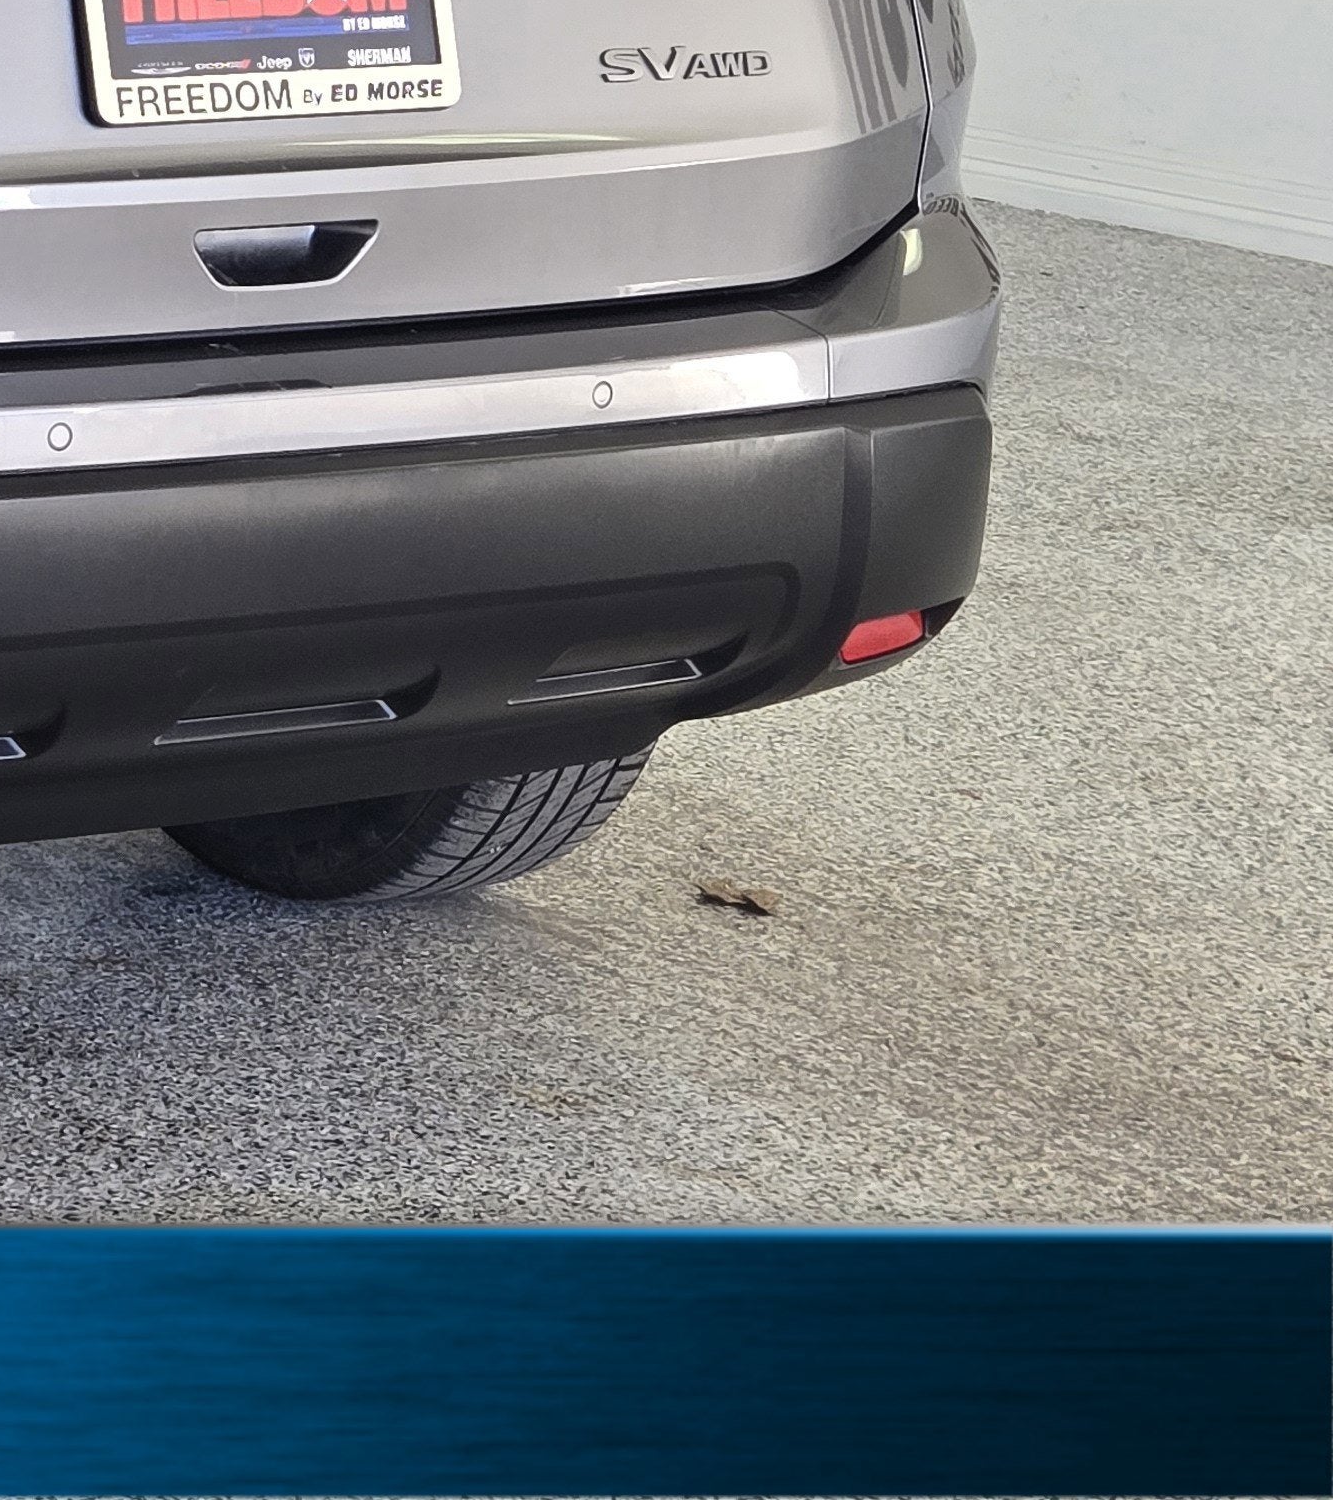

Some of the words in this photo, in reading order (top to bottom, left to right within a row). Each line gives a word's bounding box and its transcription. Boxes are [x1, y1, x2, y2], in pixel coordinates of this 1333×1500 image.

[257, 55, 293, 70] Jeep
[347, 45, 412, 67] SHERMAN
[116, 79, 293, 118] FREEDOM
[331, 84, 358, 103] ED
[367, 79, 443, 102] MORSE
